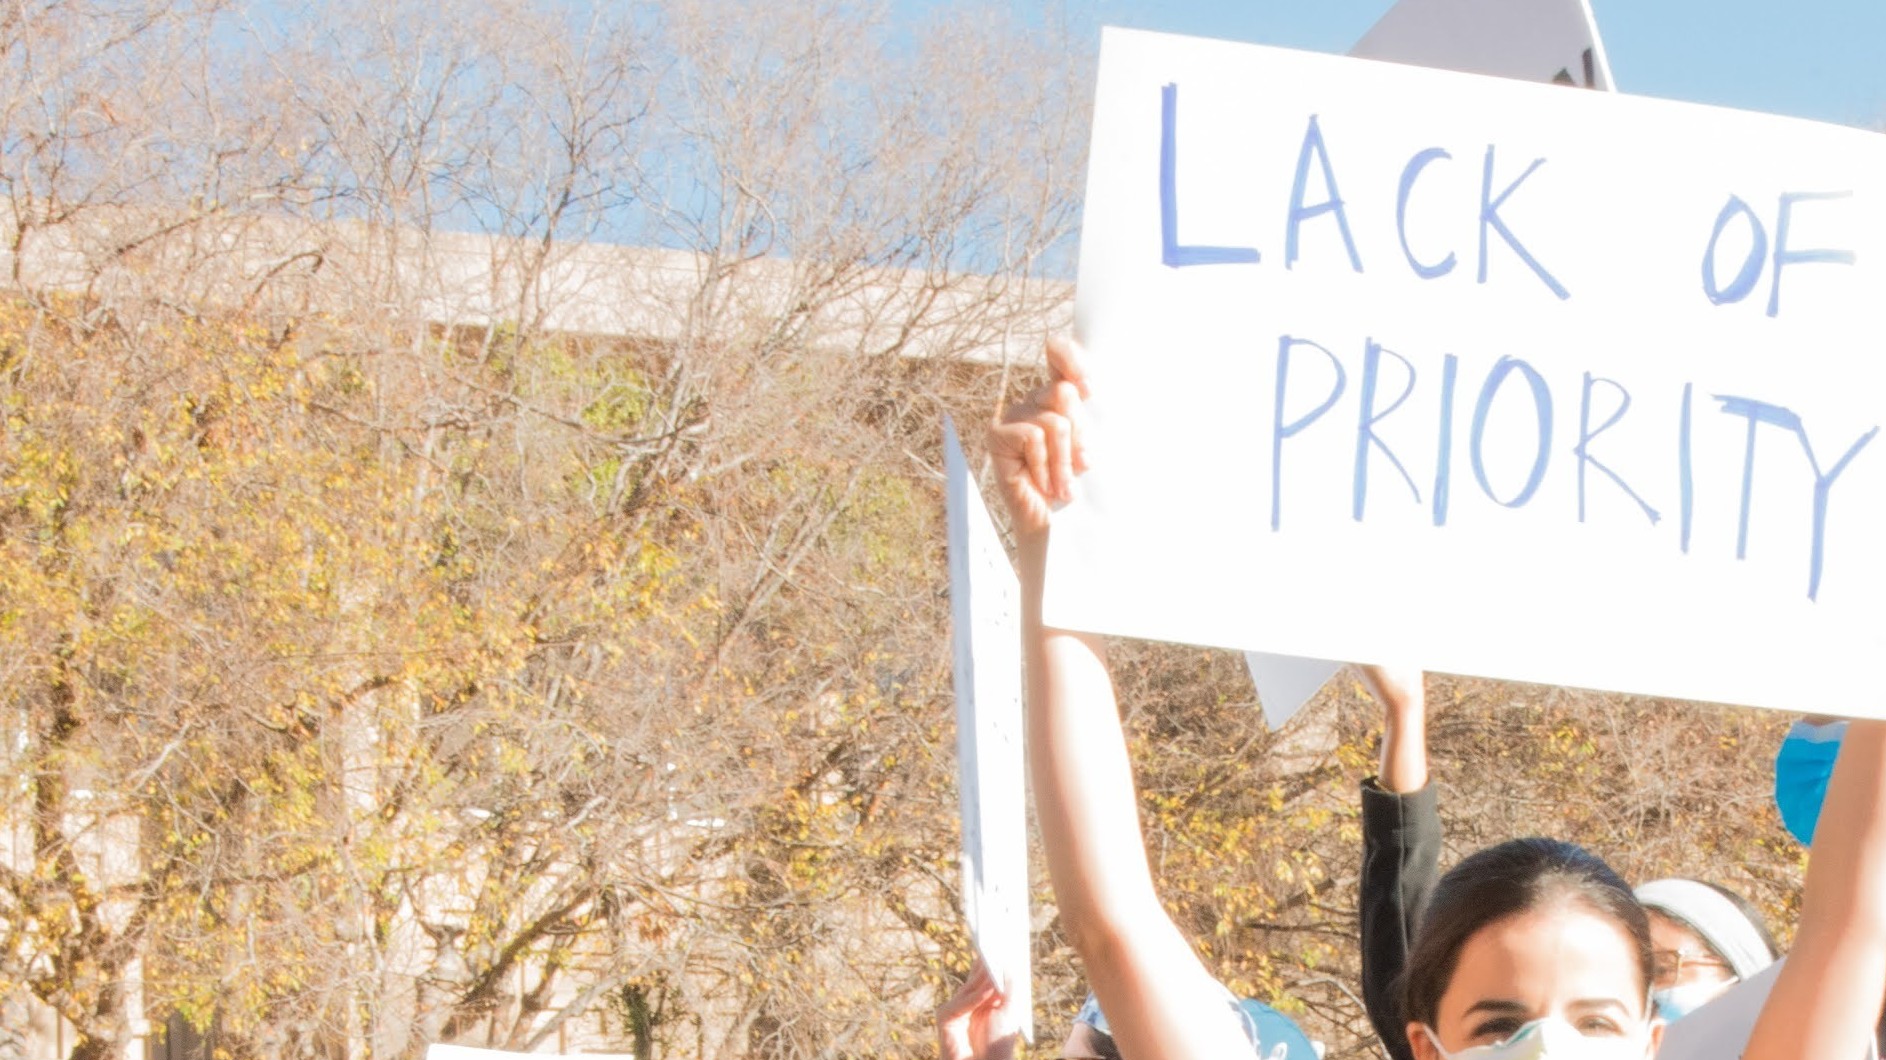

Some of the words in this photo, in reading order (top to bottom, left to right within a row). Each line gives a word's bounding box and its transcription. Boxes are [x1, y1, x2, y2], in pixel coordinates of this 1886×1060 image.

[1160, 82, 1571, 301] LACK
[1702, 189, 1857, 318] OF
[1271, 334, 1881, 603] PRIORITY
